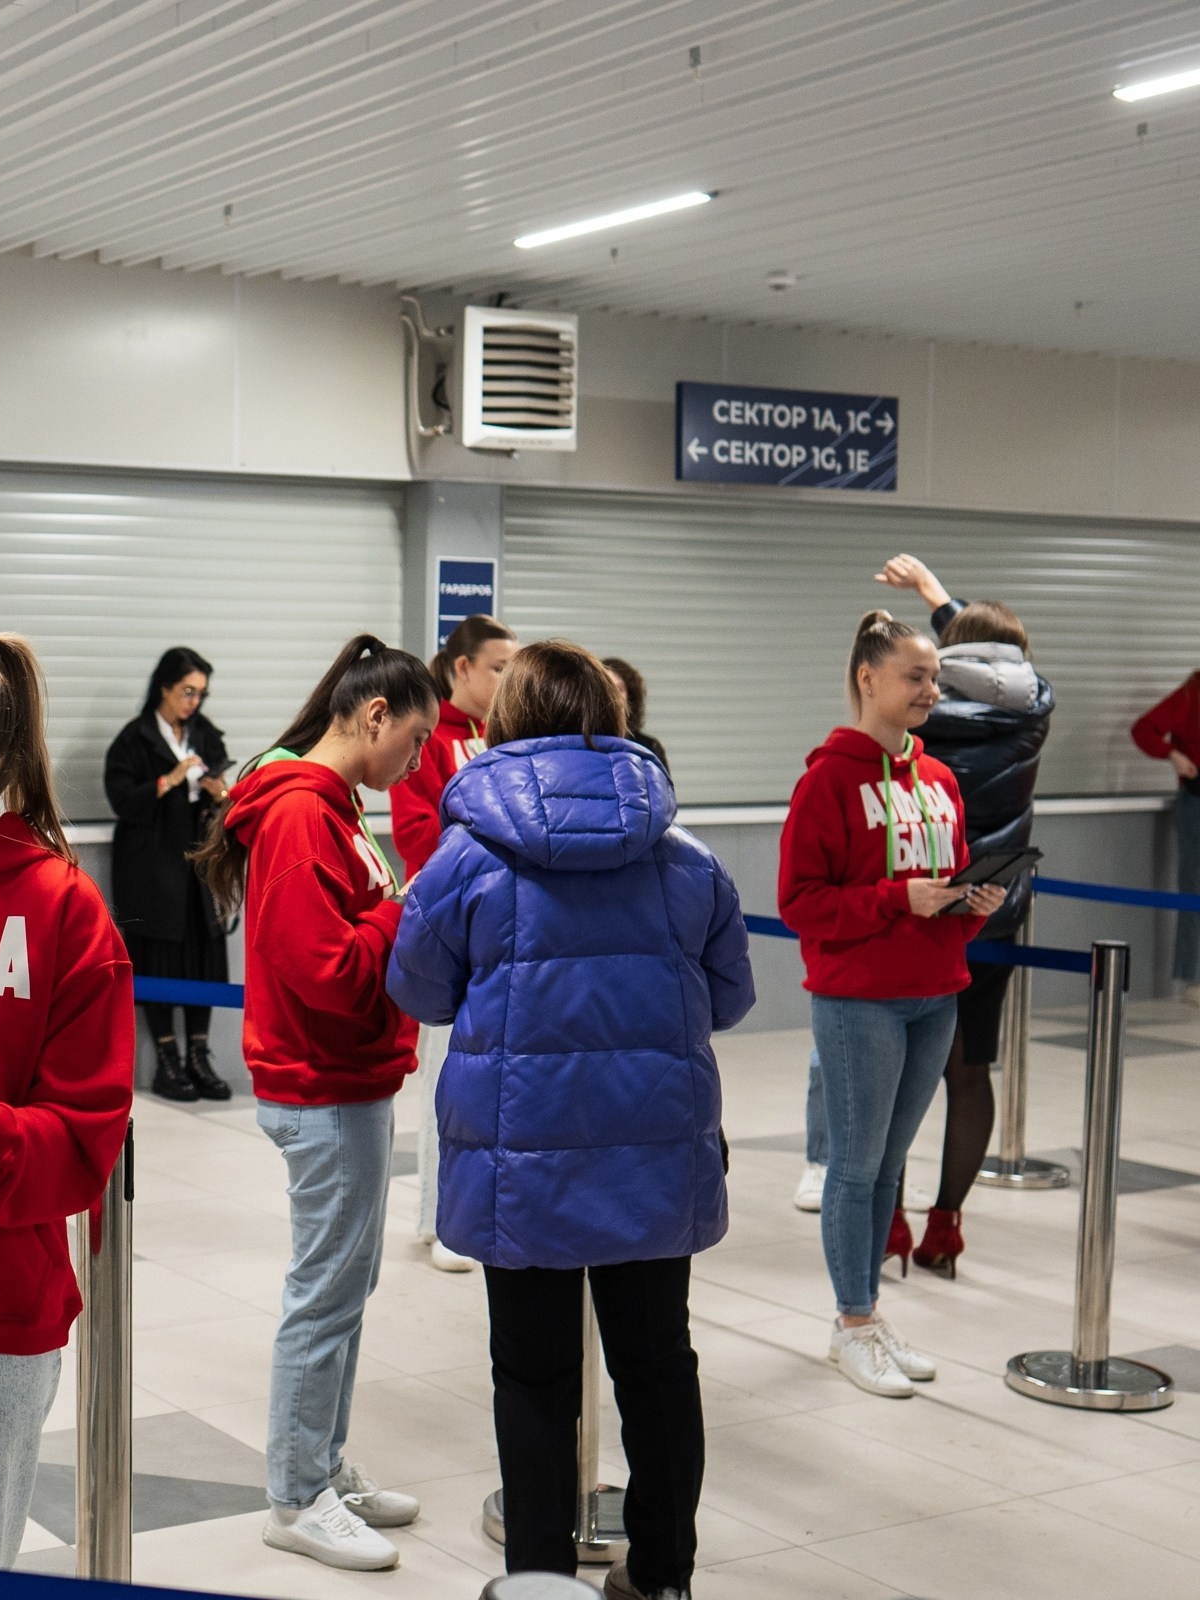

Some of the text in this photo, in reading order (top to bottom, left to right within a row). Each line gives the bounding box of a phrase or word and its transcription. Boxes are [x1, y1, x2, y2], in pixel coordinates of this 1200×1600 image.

[712, 400, 807, 428] СЕКТОР
[712, 439, 807, 467] СЕКТОР
[440, 583, 492, 596] ГАРДЕРОБ
[859, 780, 957, 830] АЛЬФА
